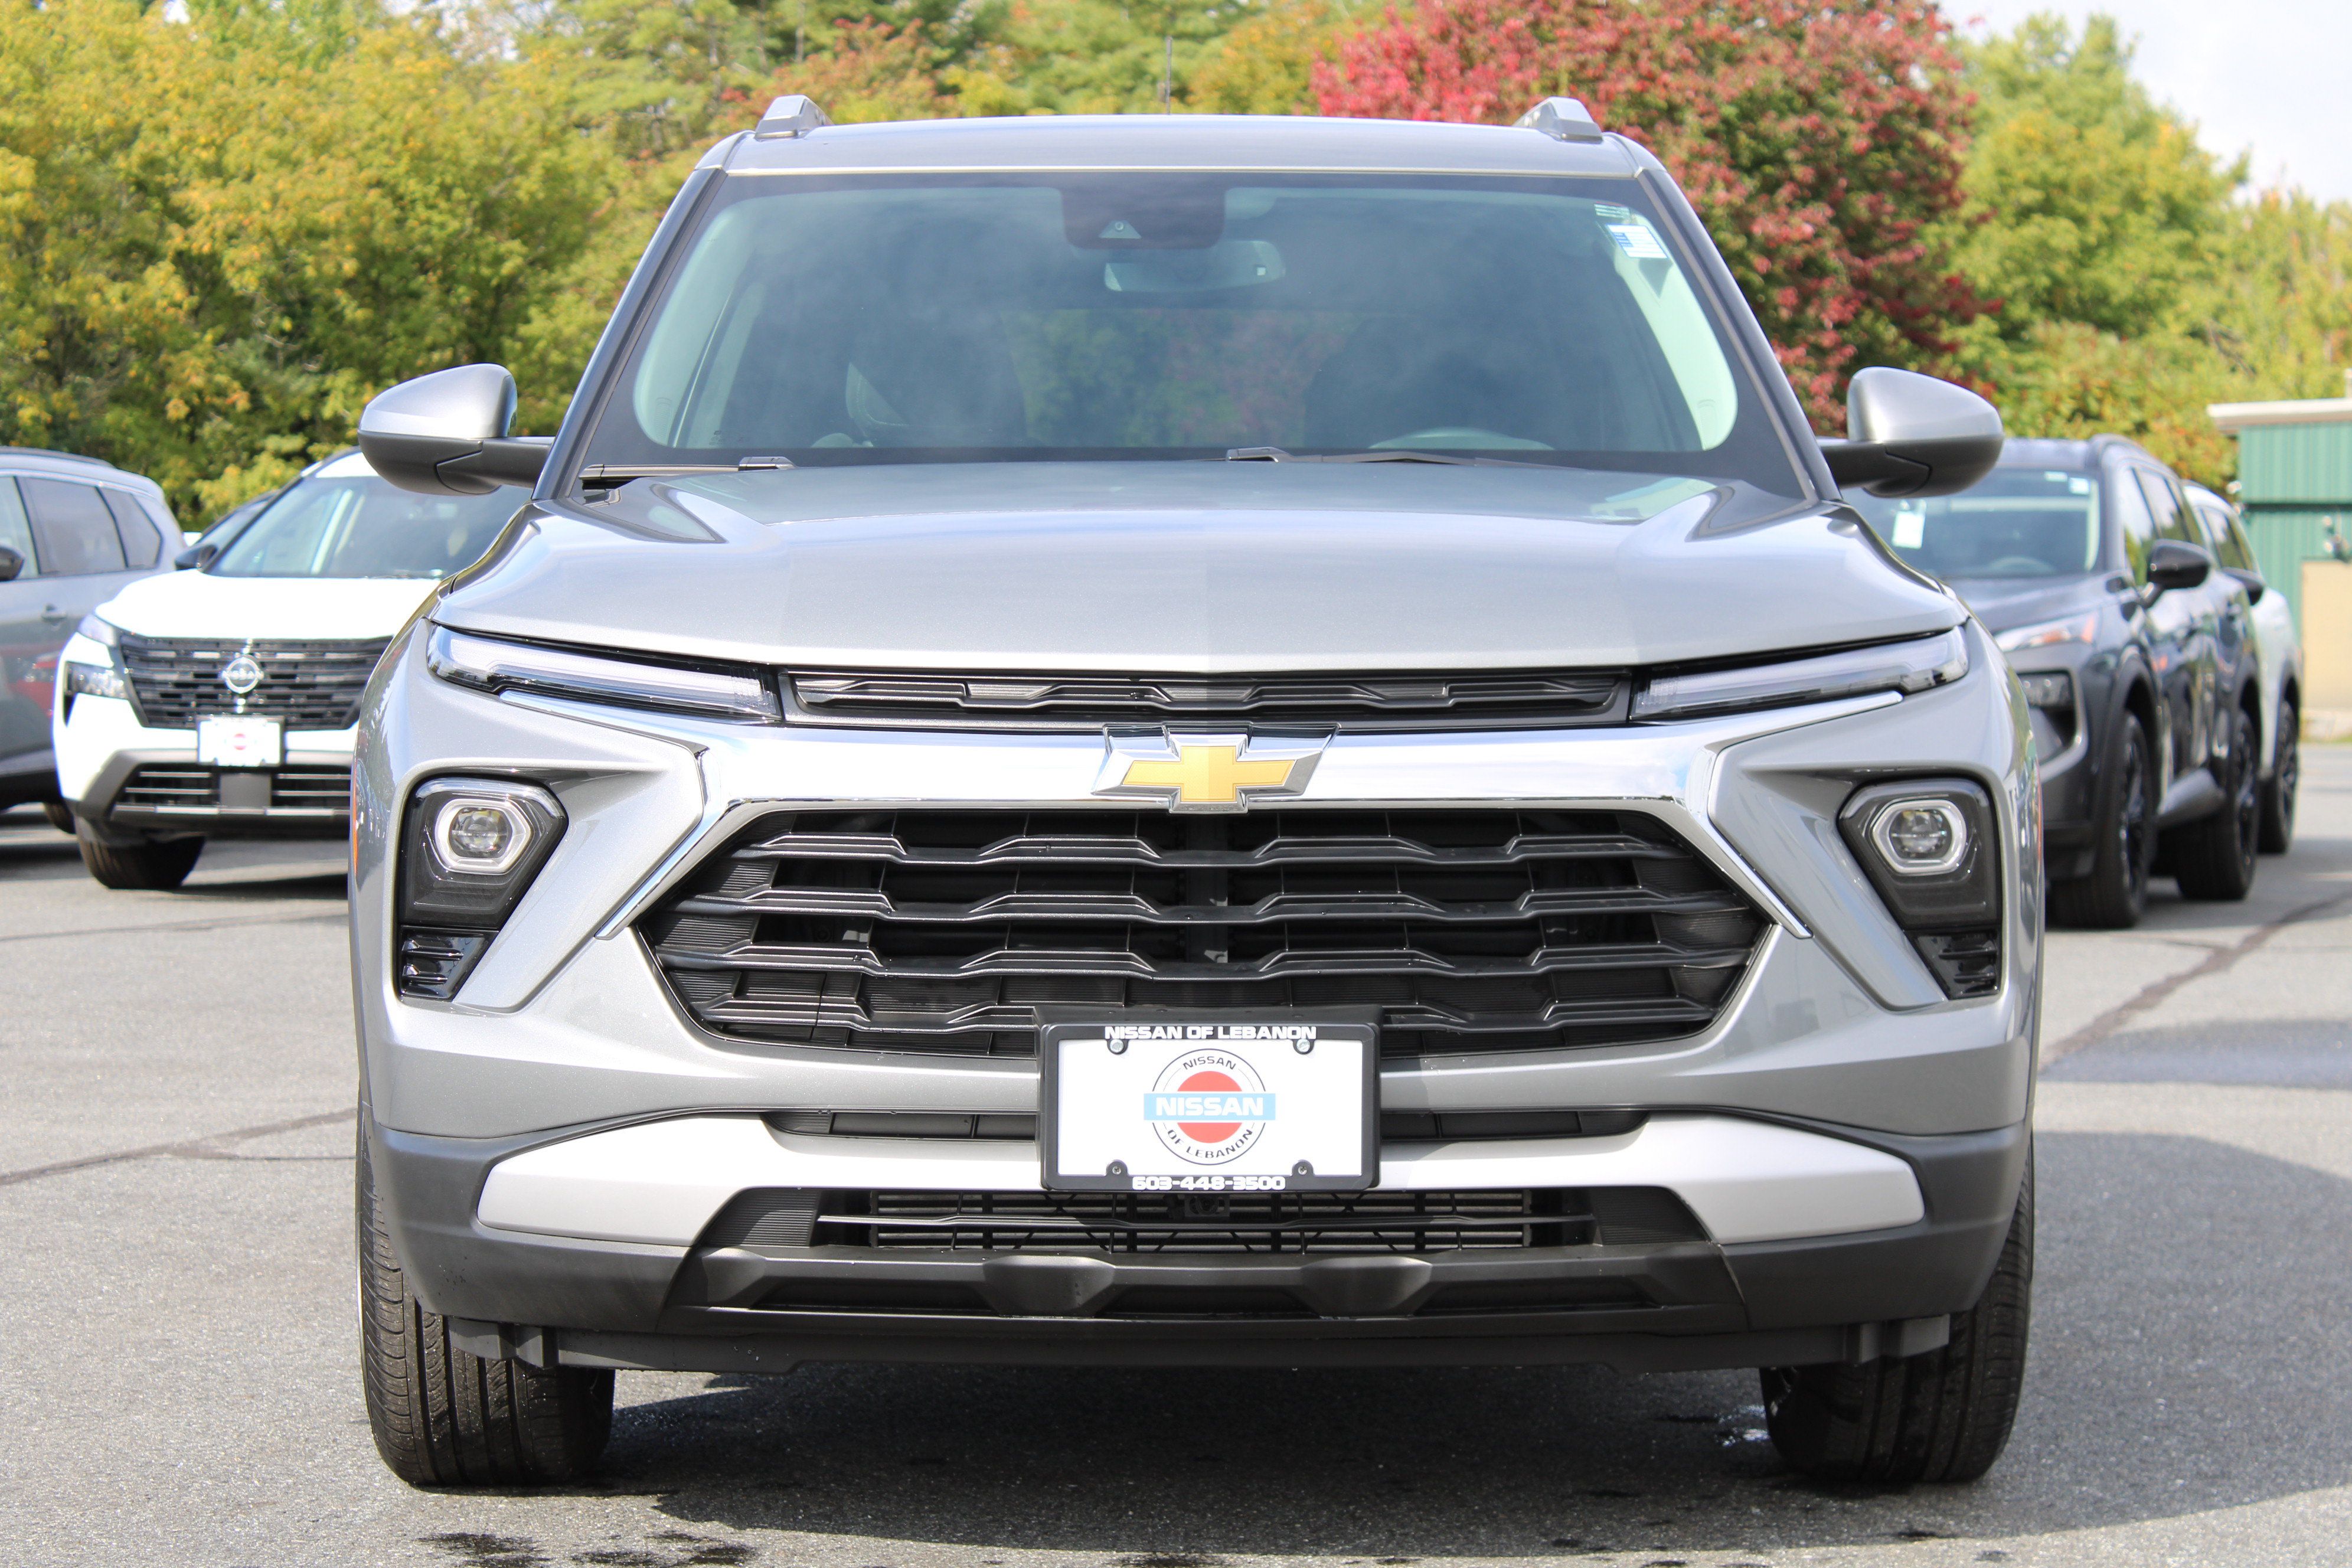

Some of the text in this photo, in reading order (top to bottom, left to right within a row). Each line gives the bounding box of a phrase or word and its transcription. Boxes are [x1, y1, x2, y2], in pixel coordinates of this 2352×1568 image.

[1105, 1026, 1317, 1039] NISSAN OF LEBANON
[1182, 1056, 1236, 1070] NISSAN
[1156, 1097, 1263, 1116] NISSAN
[1167, 1129, 1253, 1158] OF LEBANON
[1132, 1176, 1286, 1191] 603-448-3500
